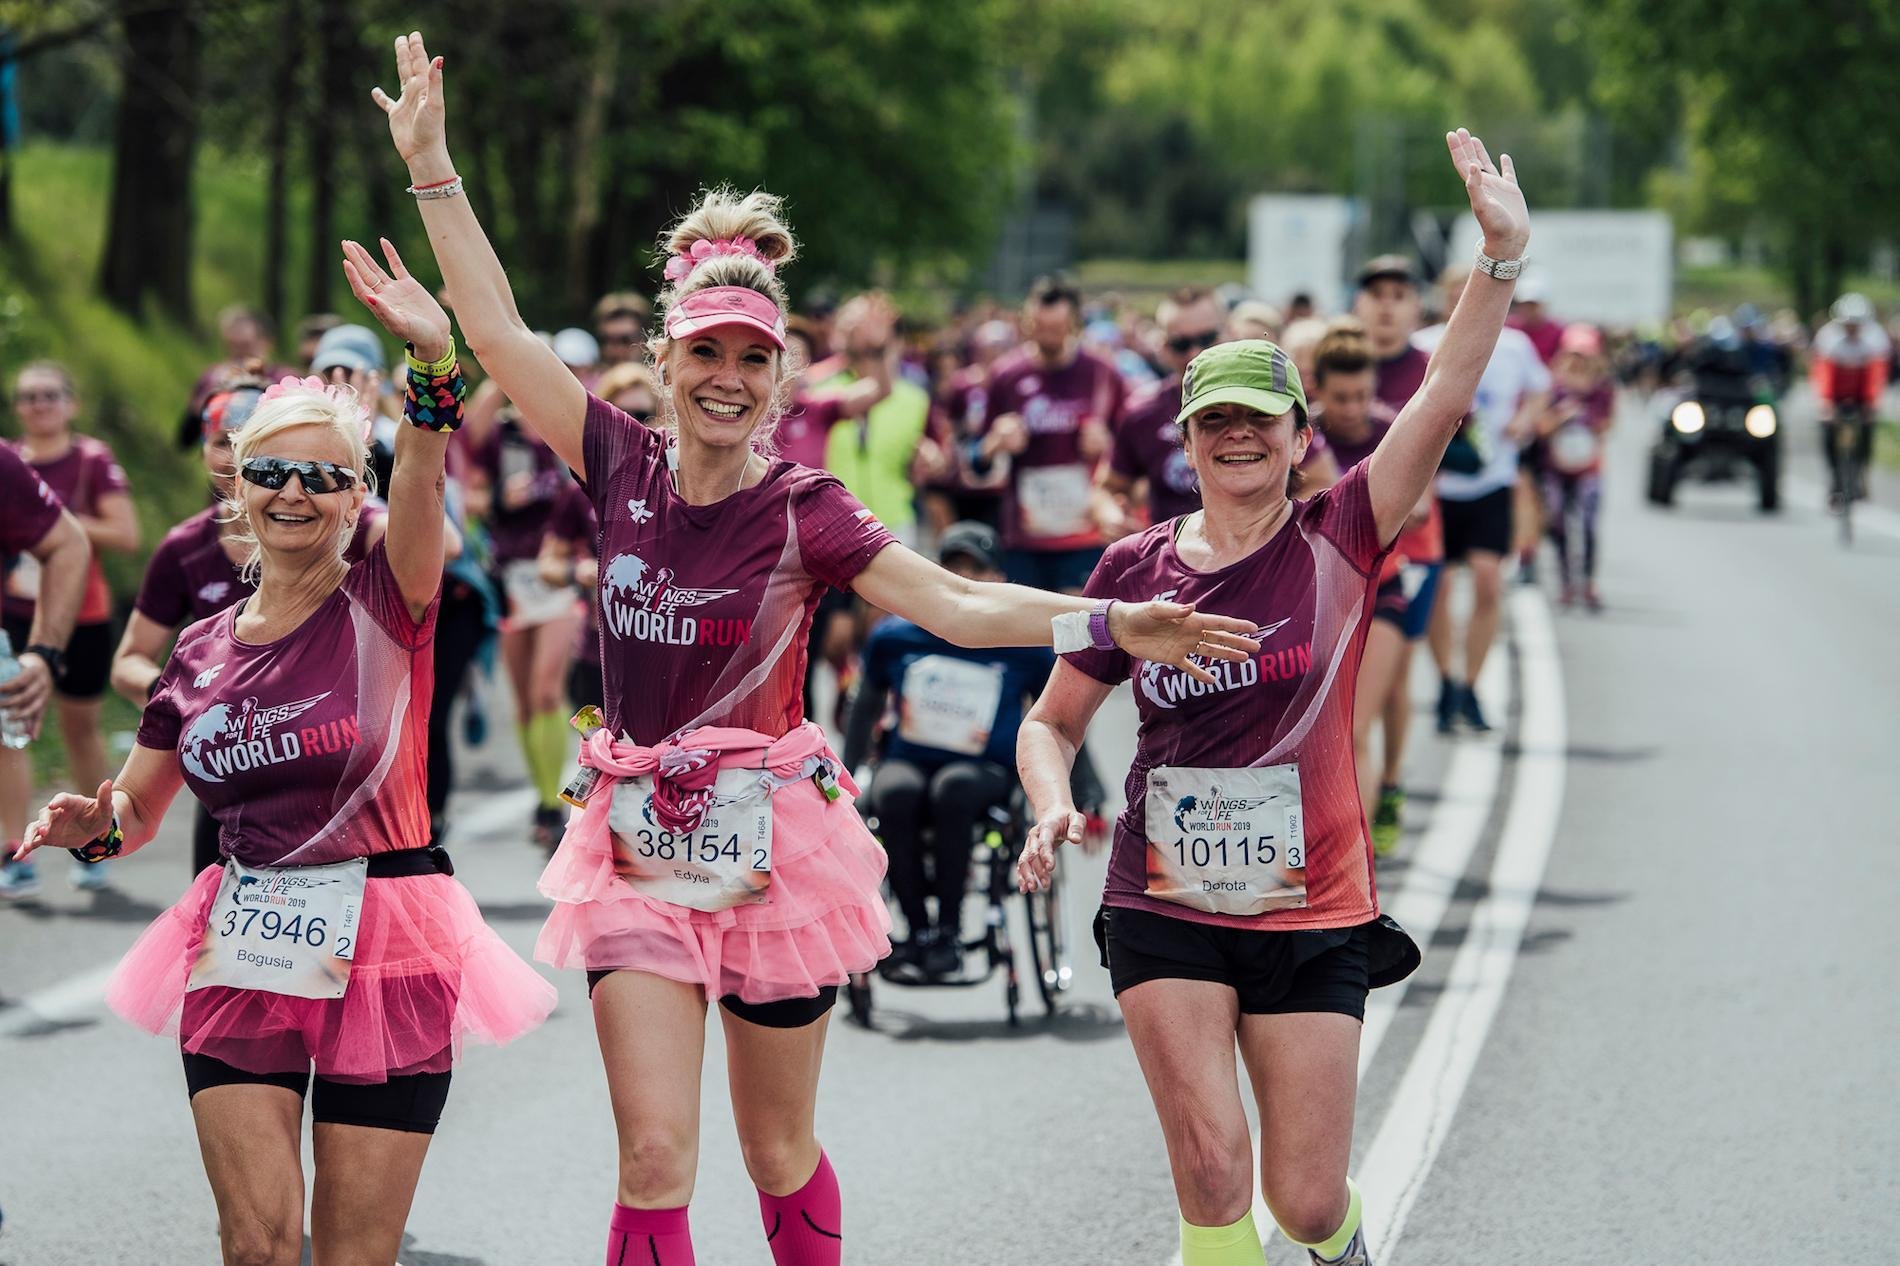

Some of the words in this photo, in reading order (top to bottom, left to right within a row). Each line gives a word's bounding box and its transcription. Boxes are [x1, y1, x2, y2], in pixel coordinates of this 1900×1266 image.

[639, 579, 698, 604] WINGS
[632, 592, 647, 602] FOR
[642, 598, 680, 616] LIFE
[227, 706, 290, 732] WINGS
[225, 731, 238, 740] FOR
[237, 723, 273, 743] LIFE
[1200, 799, 1248, 811] WINGS
[1206, 810, 1234, 821] LIFE
[1233, 822, 1251, 831] 2019
[636, 829, 742, 863] 38154
[1174, 835, 1276, 867] 10115
[752, 849, 767, 870] 2
[1288, 847, 1301, 867] 3
[261, 877, 309, 888] WINGS
[262, 884, 292, 896] LIFE
[1202, 880, 1247, 892] Dorota
[288, 897, 306, 909] 2019
[220, 908, 328, 947] 37946
[334, 937, 351, 958] 2
[236, 949, 294, 970] Bogusia
